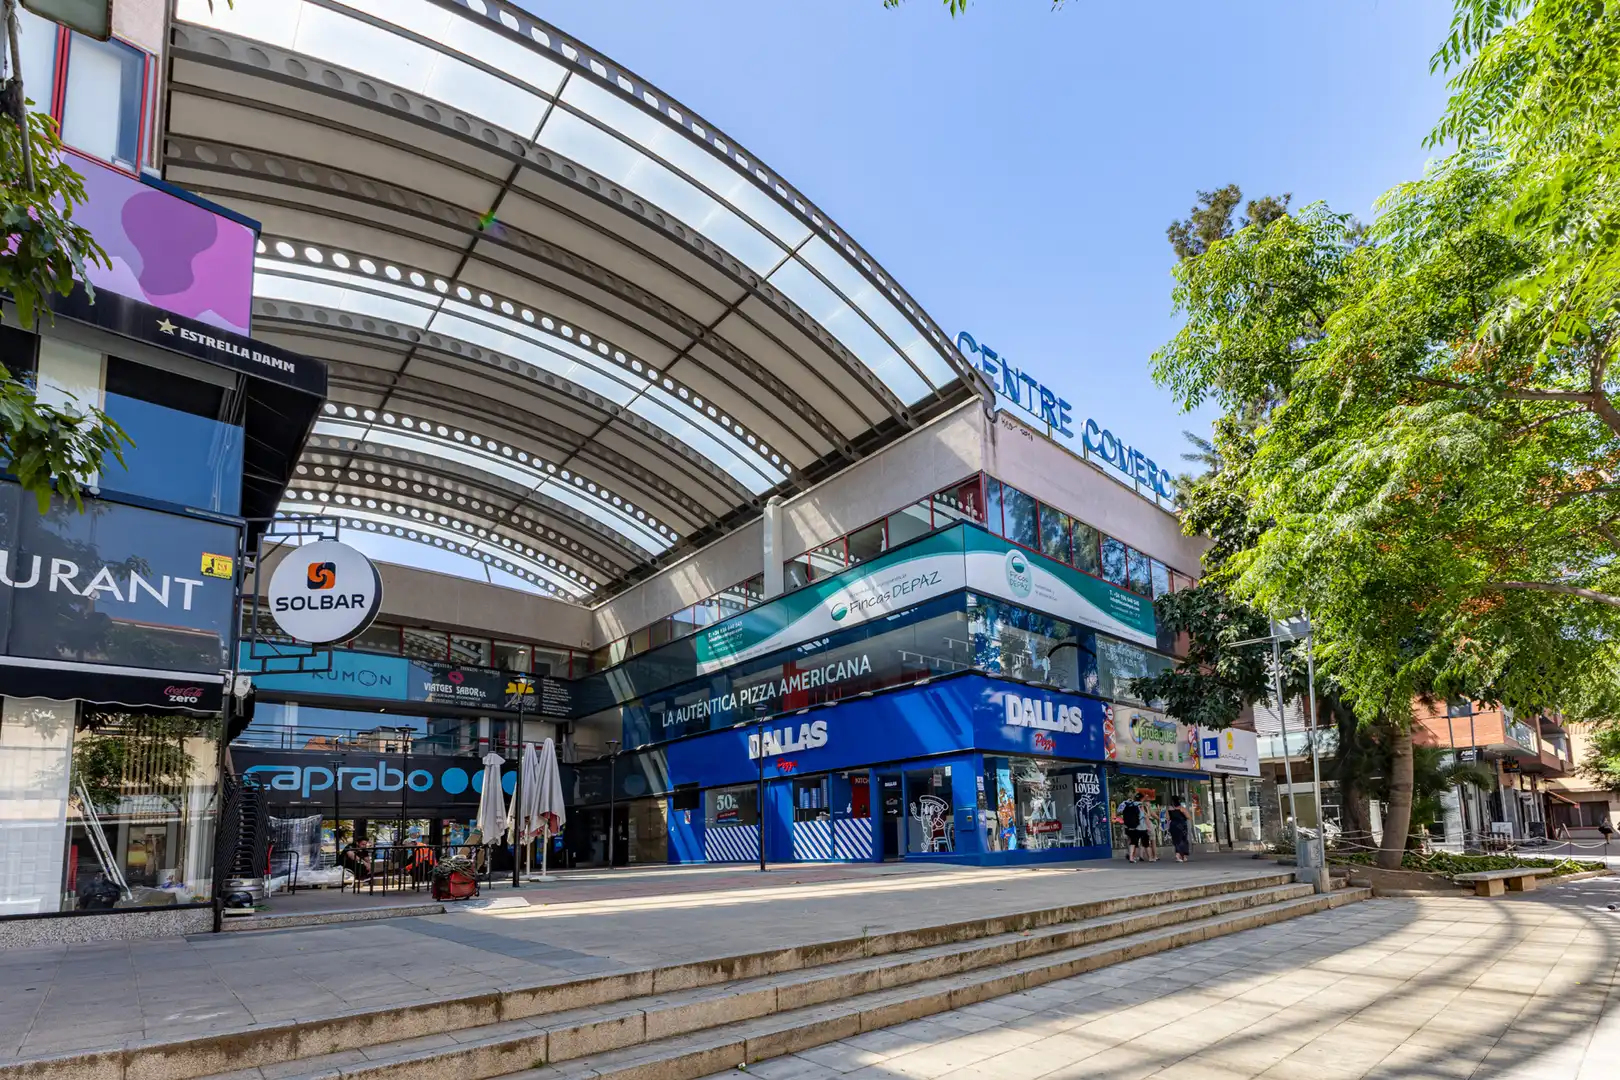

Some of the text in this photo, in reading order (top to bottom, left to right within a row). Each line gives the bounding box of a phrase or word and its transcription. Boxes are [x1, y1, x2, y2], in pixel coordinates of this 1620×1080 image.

[181, 327, 296, 373] ESTRELLA DAMM
[953, 331, 1176, 502] CENTRE COMERC
[892, 570, 942, 598] DEPAZ
[275, 594, 365, 612] SOLBAR
[169, 694, 198, 704] zero
[424, 683, 452, 693] VIATGES
[456, 686, 478, 697] SABOR
[662, 712, 674, 728] LA
[675, 692, 737, 724] AUTÉNTICA
[740, 681, 776, 707] PIZZA
[779, 654, 872, 698] AMERICANA
[1005, 694, 1084, 734] DALLAS
[748, 720, 828, 760] DALLAS
[1132, 715, 1177, 745] Verdaguer
[242, 761, 434, 798] caprabo
[1074, 783, 1100, 795] LOVERS
[1077, 773, 1099, 784] PIZZA
